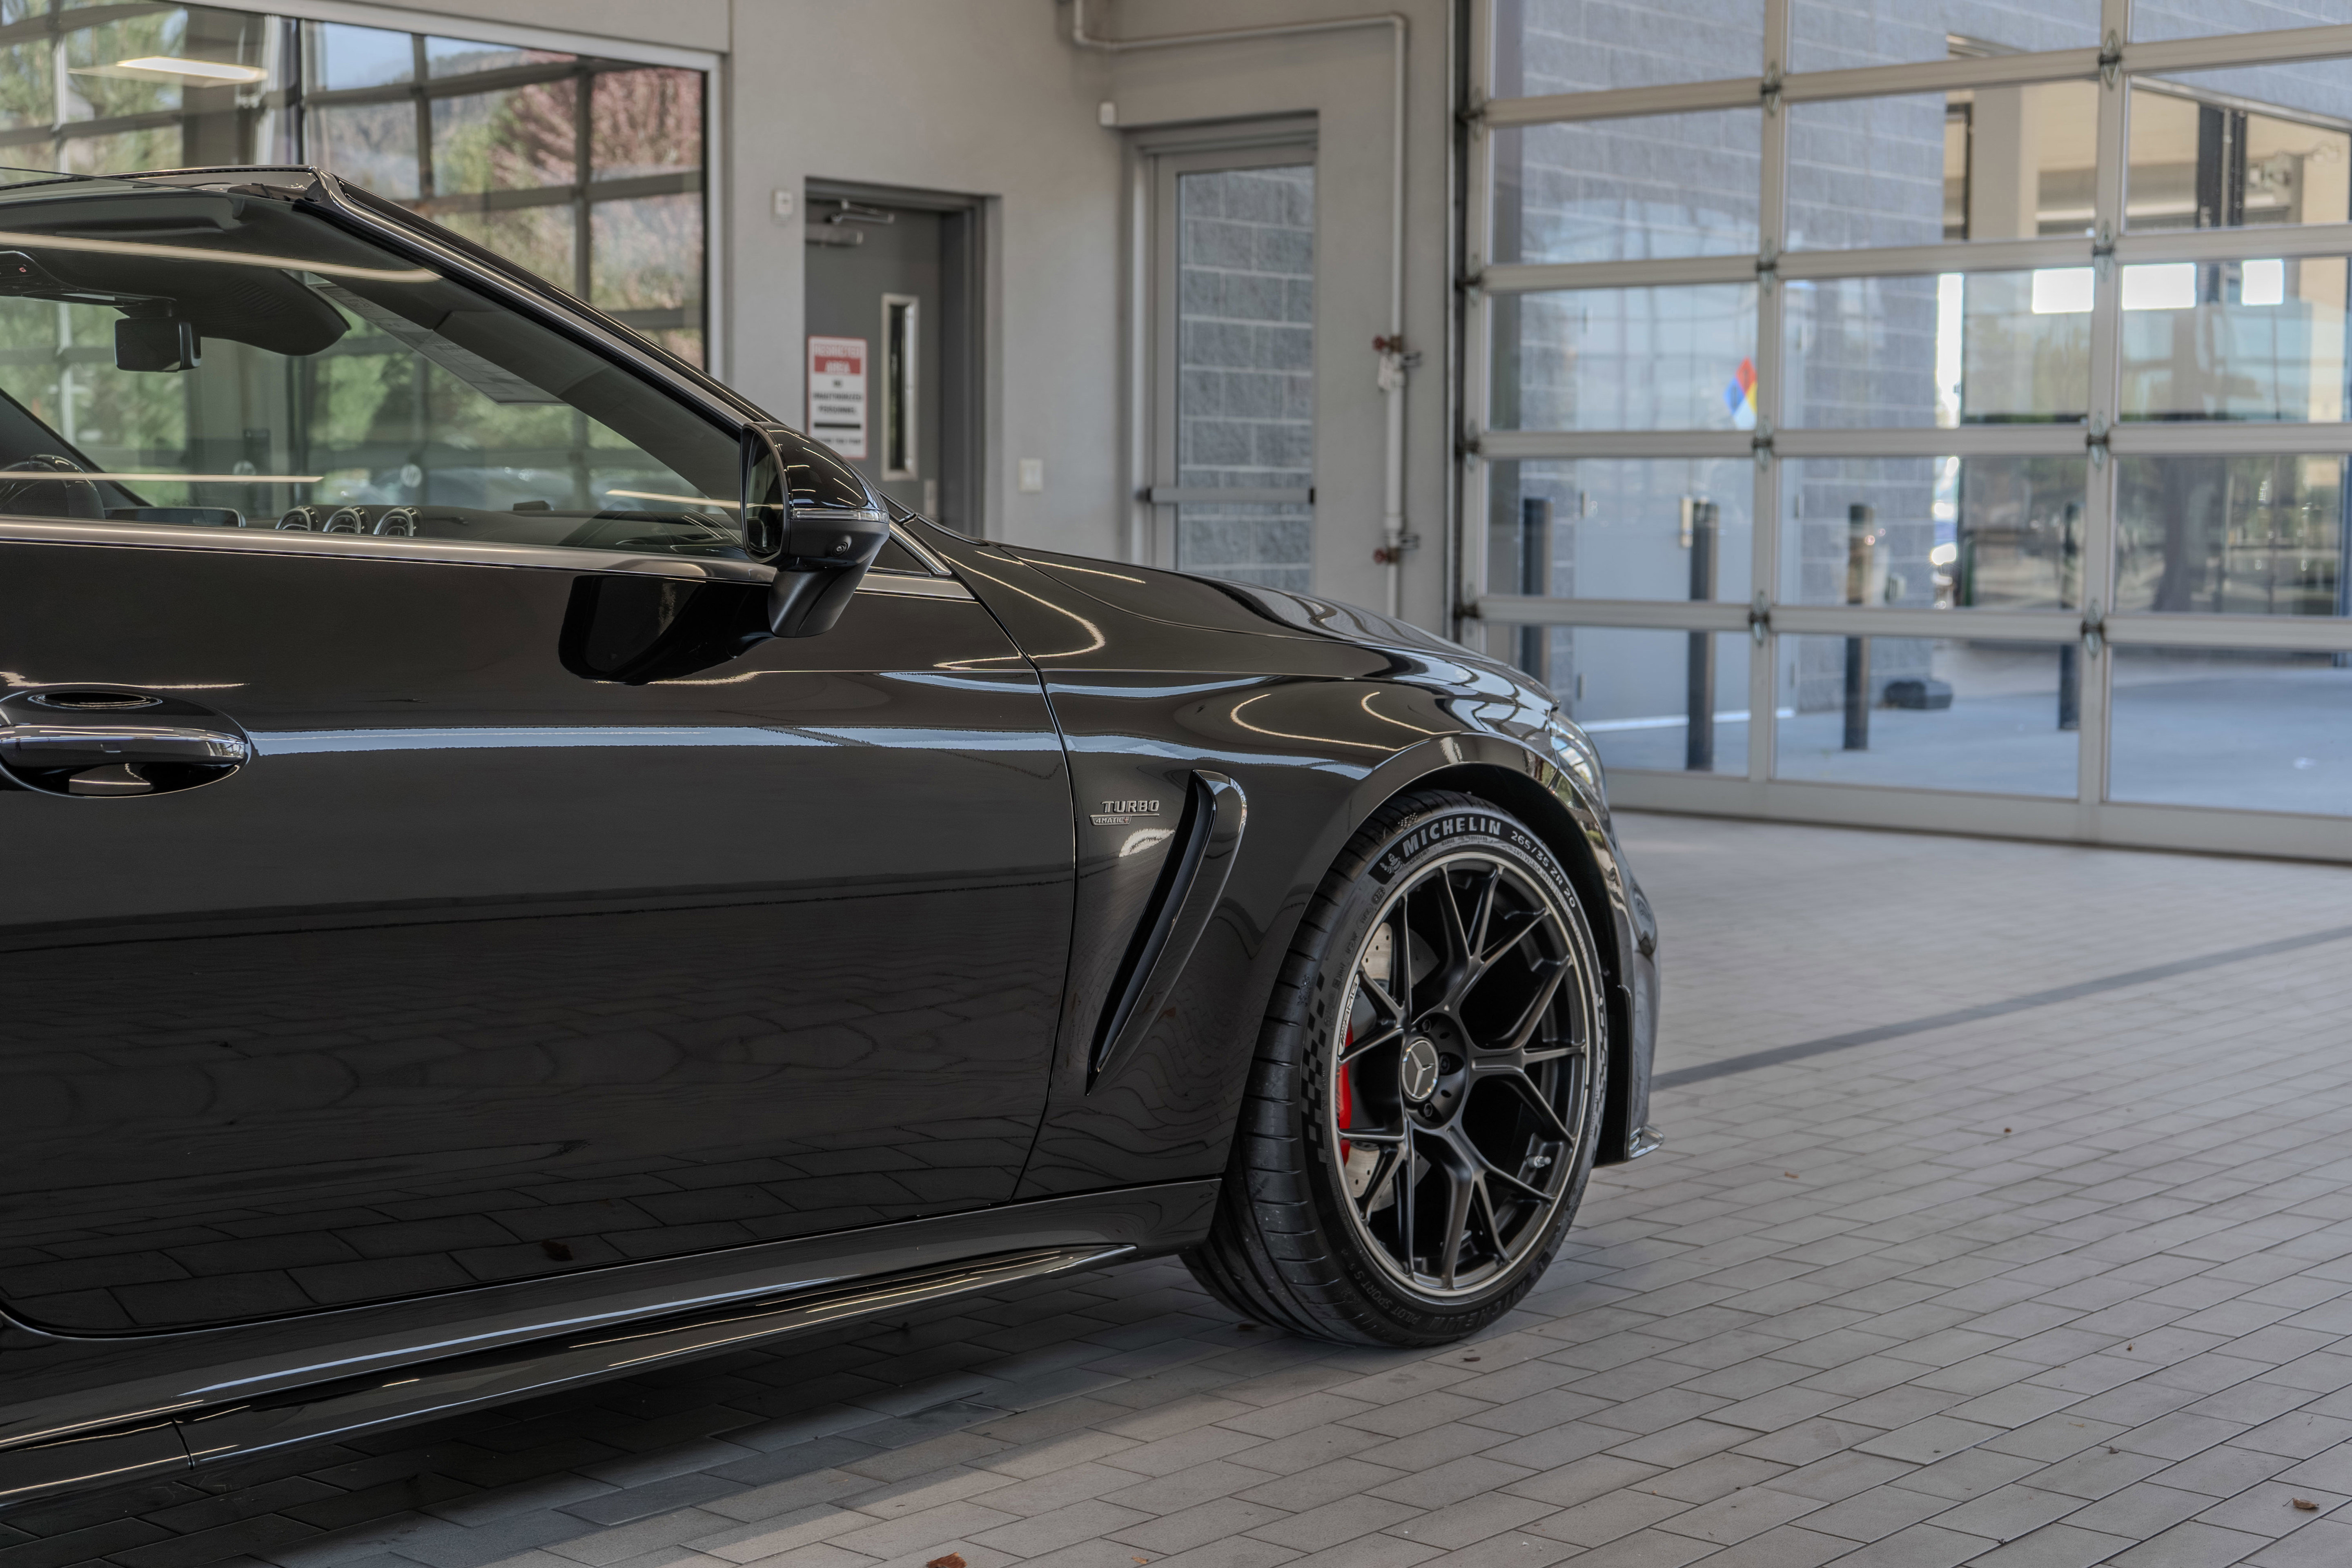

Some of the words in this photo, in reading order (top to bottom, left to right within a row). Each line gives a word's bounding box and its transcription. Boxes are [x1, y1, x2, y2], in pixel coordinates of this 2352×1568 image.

[1101, 800, 1159, 813] TURBO
[1403, 817, 1501, 858] MICHELIN
[1511, 831, 1550, 867] 265/35
[1550, 866, 1563, 885] ZR
[1564, 887, 1576, 907] 20
[1343, 982, 1358, 1025] AMG
[1354, 1271, 1365, 1279] S
[1361, 1281, 1393, 1309] SPORT
[1428, 1281, 1526, 1333] MICHELIN
[1390, 1306, 1422, 1324] PILOT
